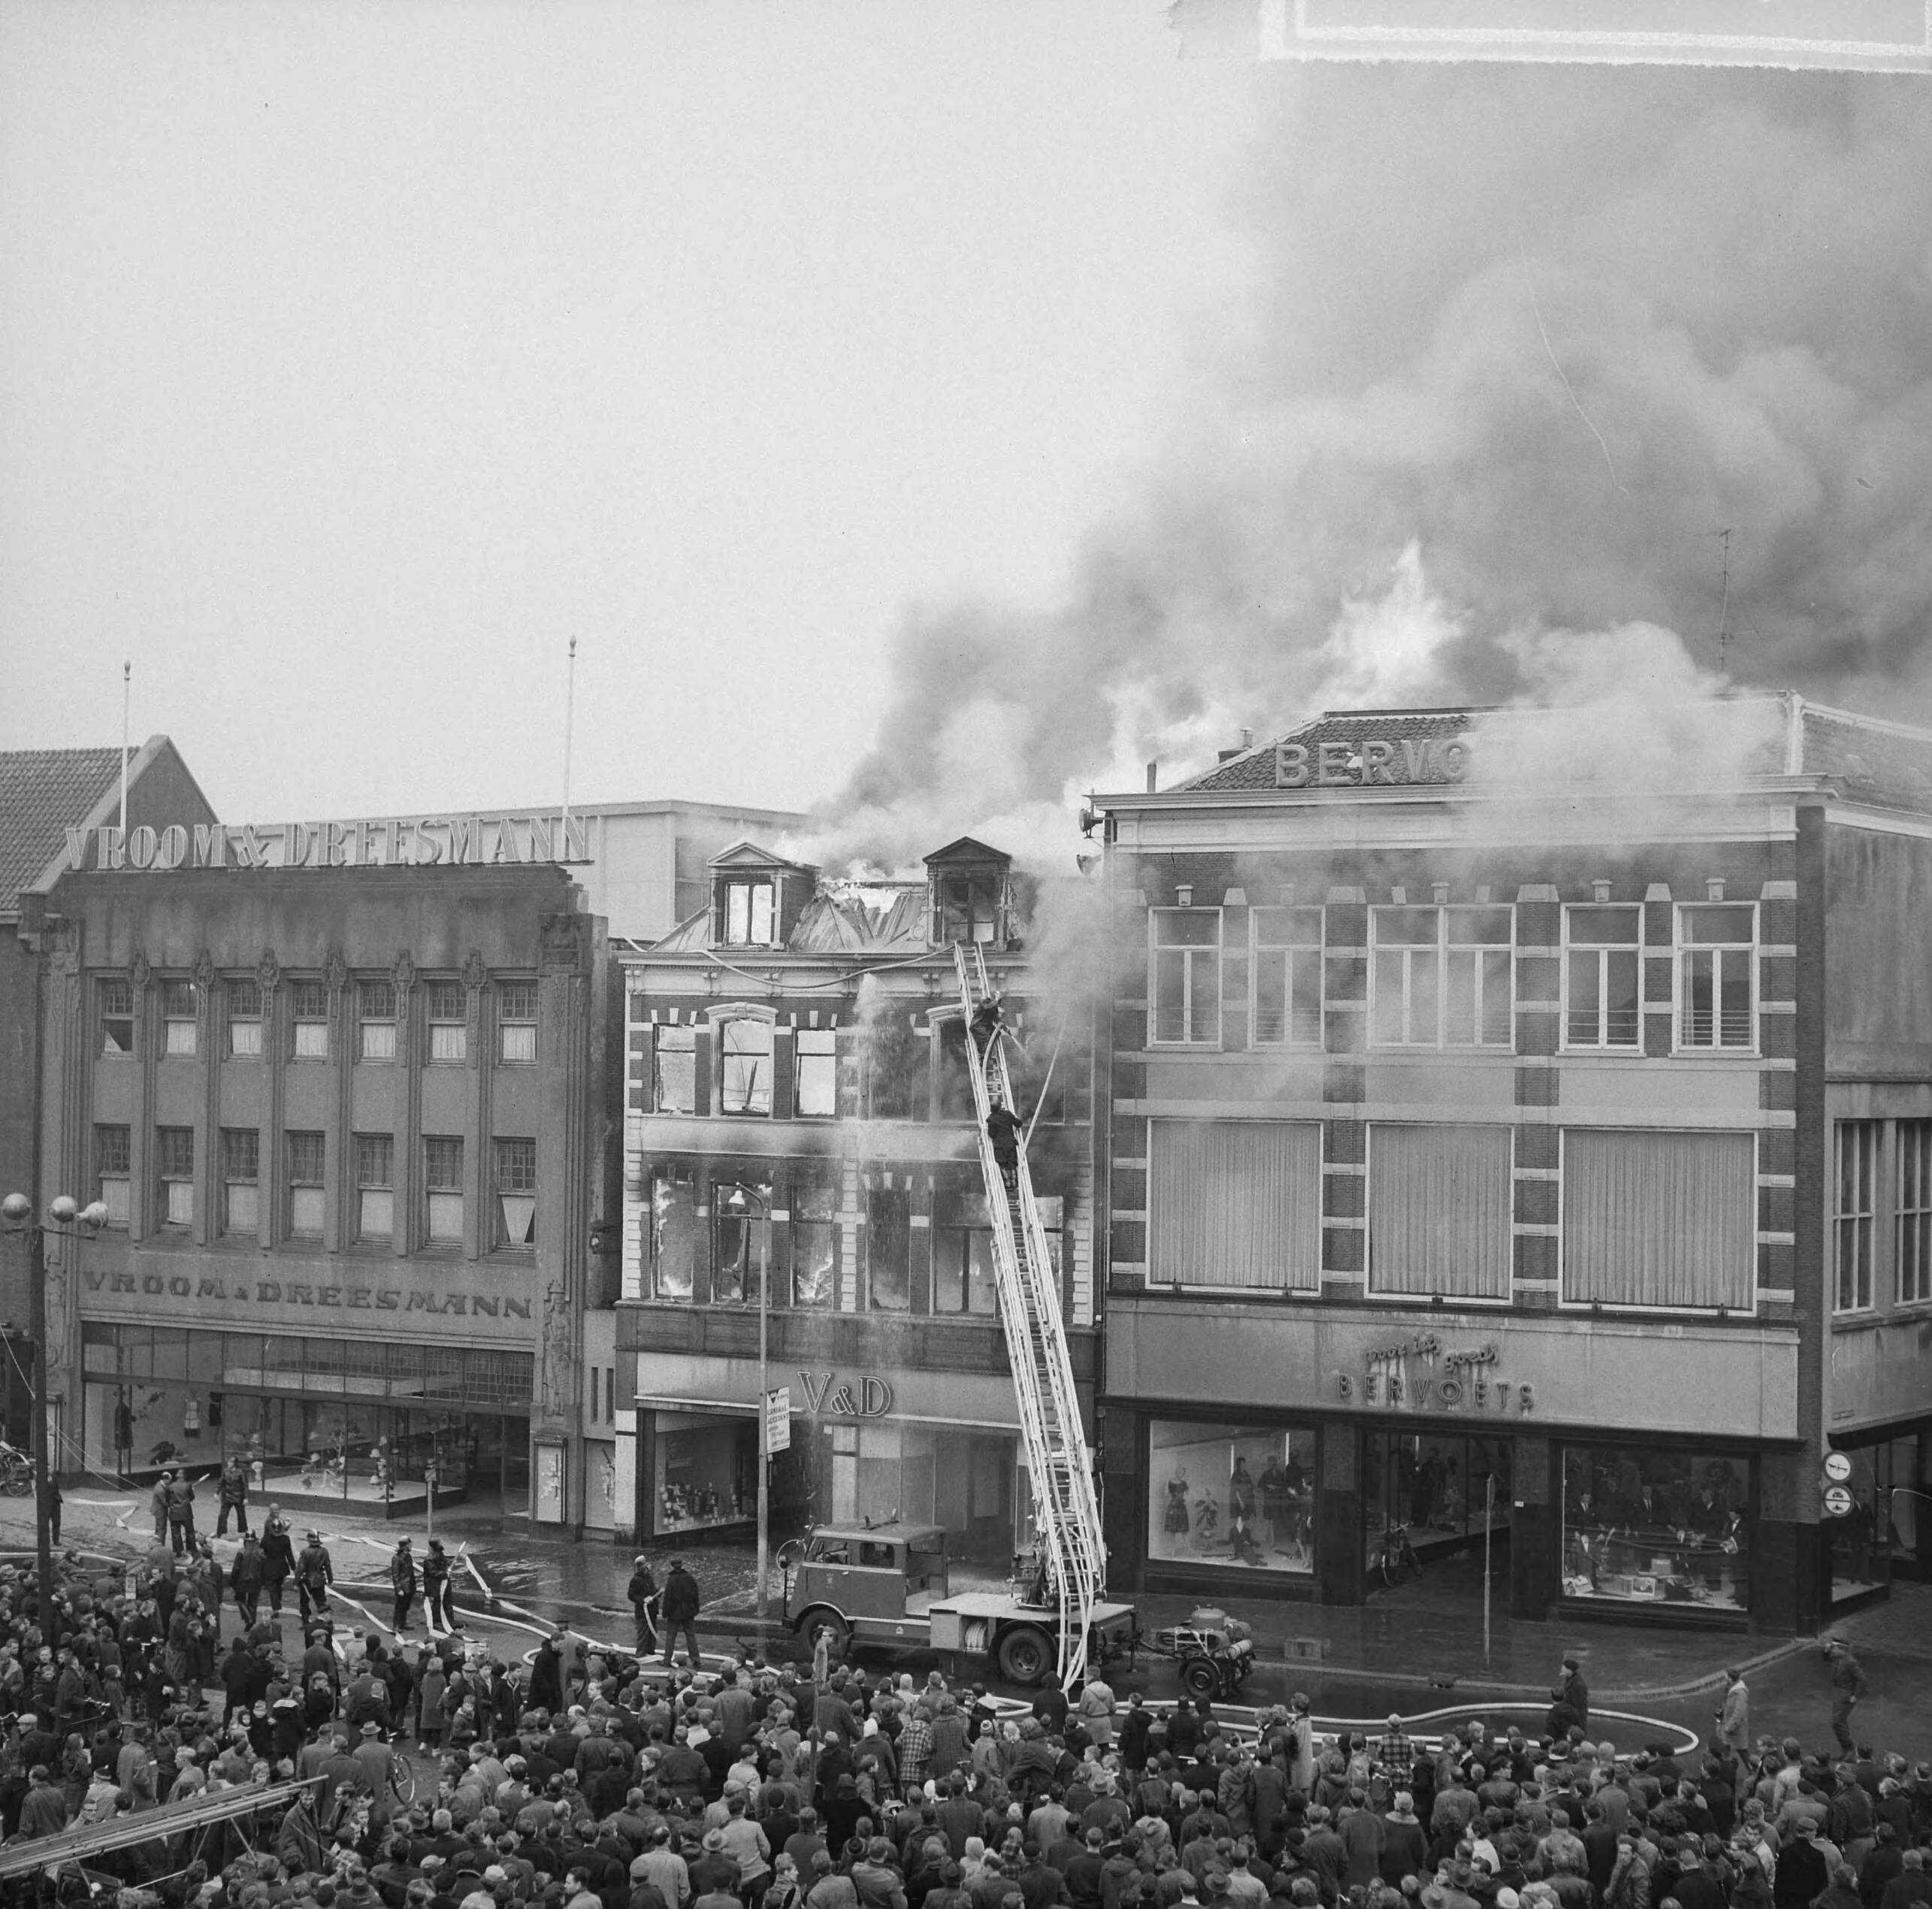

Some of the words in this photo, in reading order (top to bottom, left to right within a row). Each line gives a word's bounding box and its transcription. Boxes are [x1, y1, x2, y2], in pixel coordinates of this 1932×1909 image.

[66, 824, 227, 869] VROOM
[237, 823, 270, 866] &
[283, 816, 593, 867] DREESMANN
[83, 1271, 227, 1299] VROOM
[234, 1287, 249, 1301] &
[257, 1282, 531, 1319] DREESMANN
[797, 1371, 891, 1417] V&D
[1338, 1374, 1532, 1410] BERVOETS
